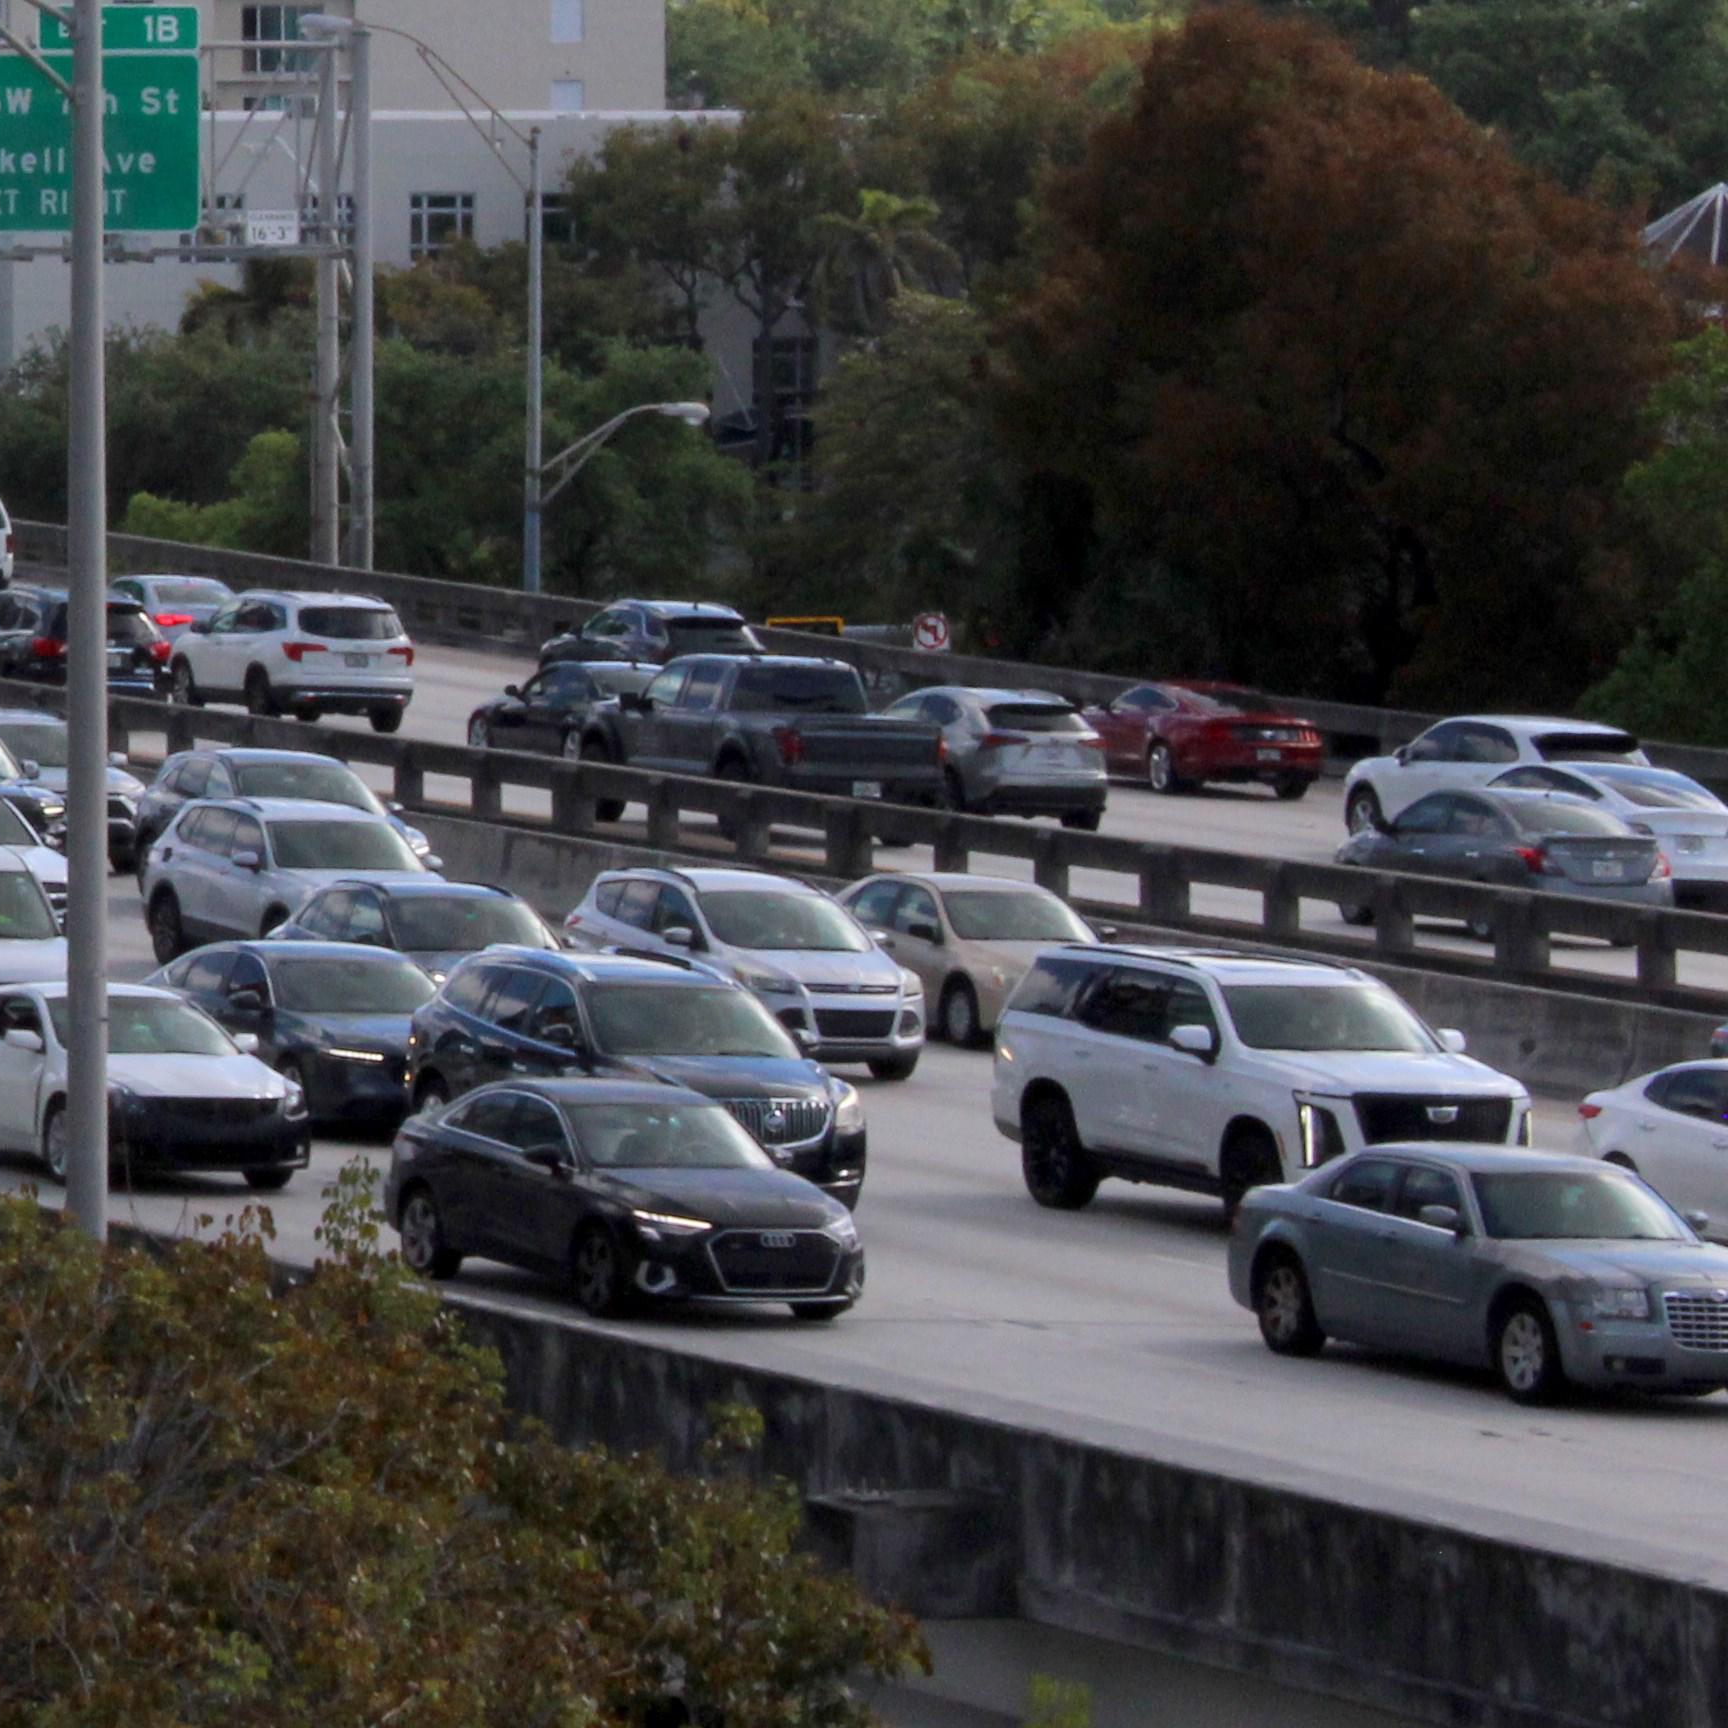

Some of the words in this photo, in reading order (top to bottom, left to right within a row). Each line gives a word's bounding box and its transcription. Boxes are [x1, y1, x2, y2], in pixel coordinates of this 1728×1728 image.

[144, 15, 179, 42] 1B
[140, 86, 180, 115] St
[40, 188, 127, 215] RIT
